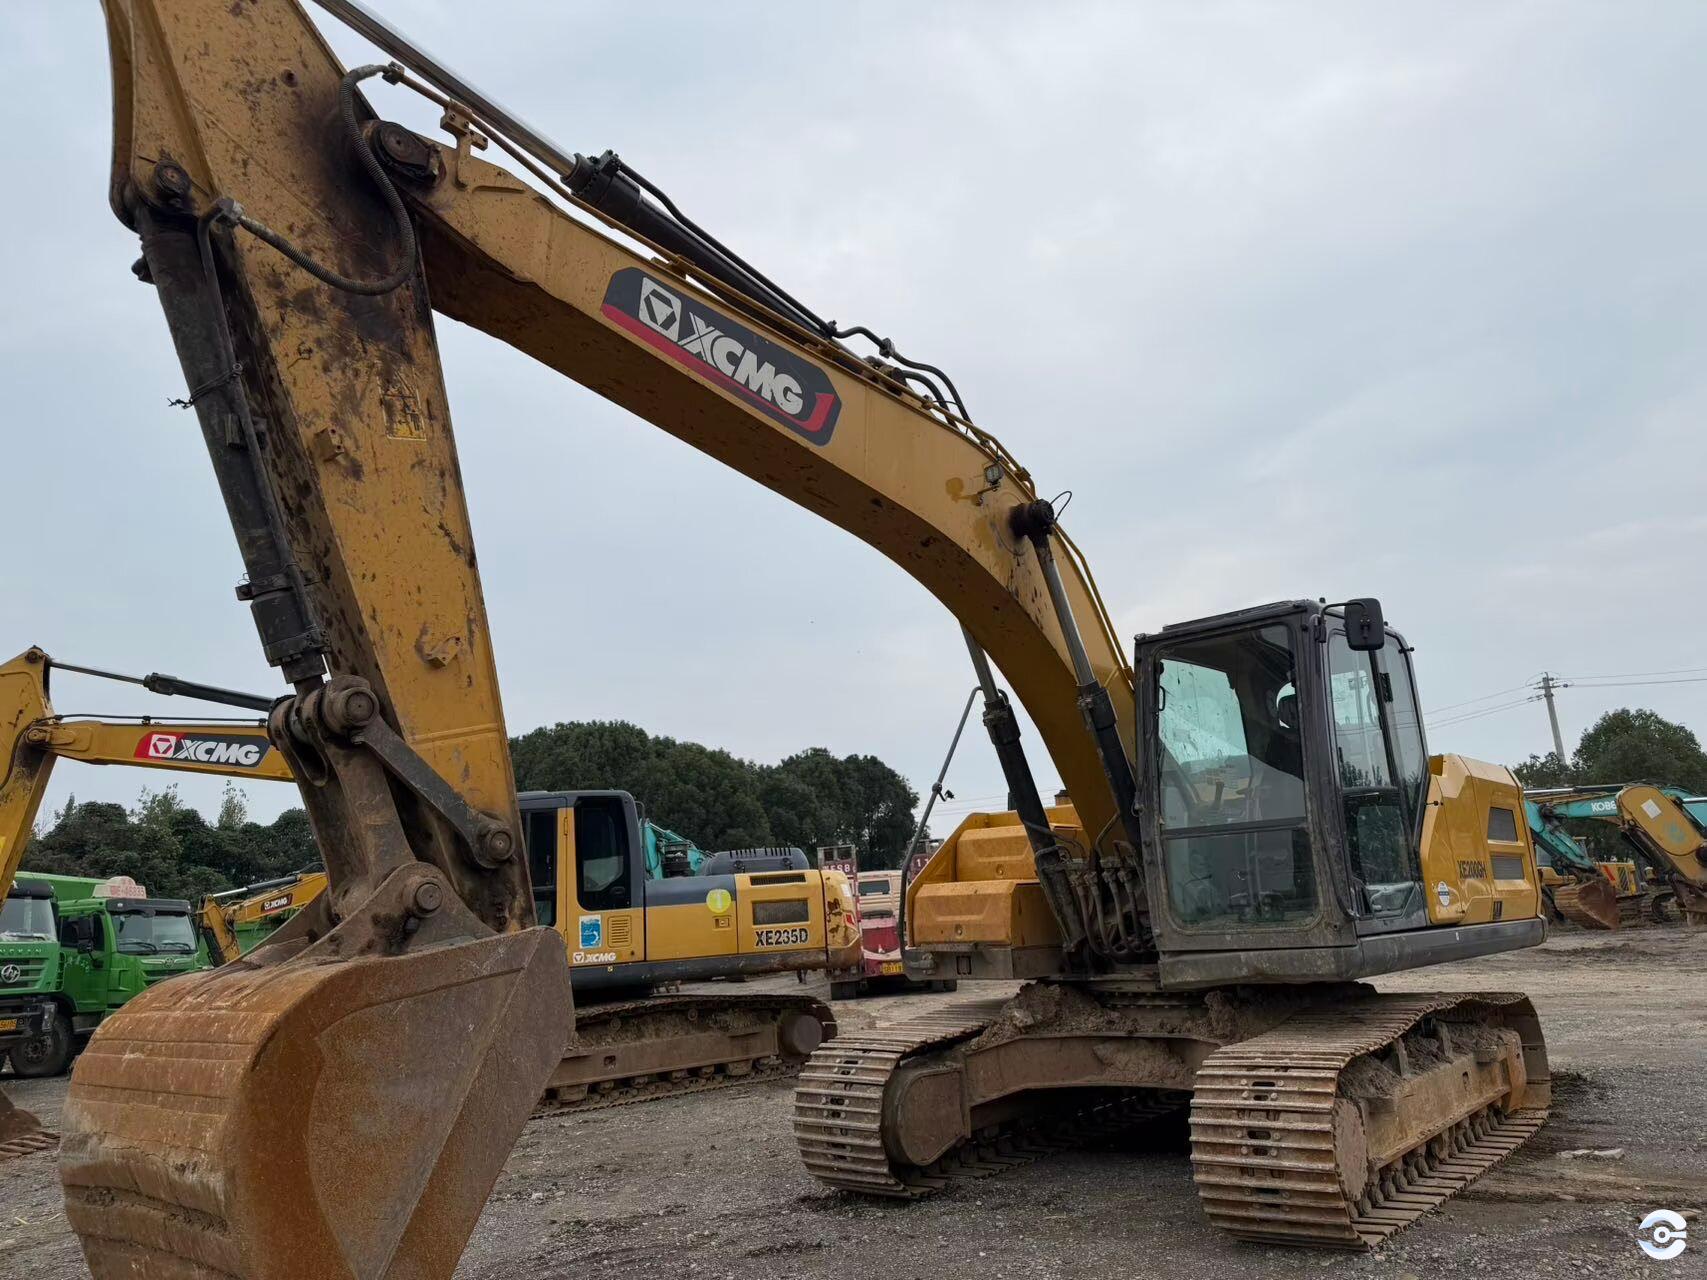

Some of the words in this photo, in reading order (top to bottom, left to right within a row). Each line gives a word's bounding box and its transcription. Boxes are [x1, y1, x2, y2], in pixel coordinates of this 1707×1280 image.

[677, 311, 804, 416] XCMG
[172, 738, 261, 766] XCMG
[754, 927, 809, 947] XE235D
[585, 952, 617, 963] XCMG
